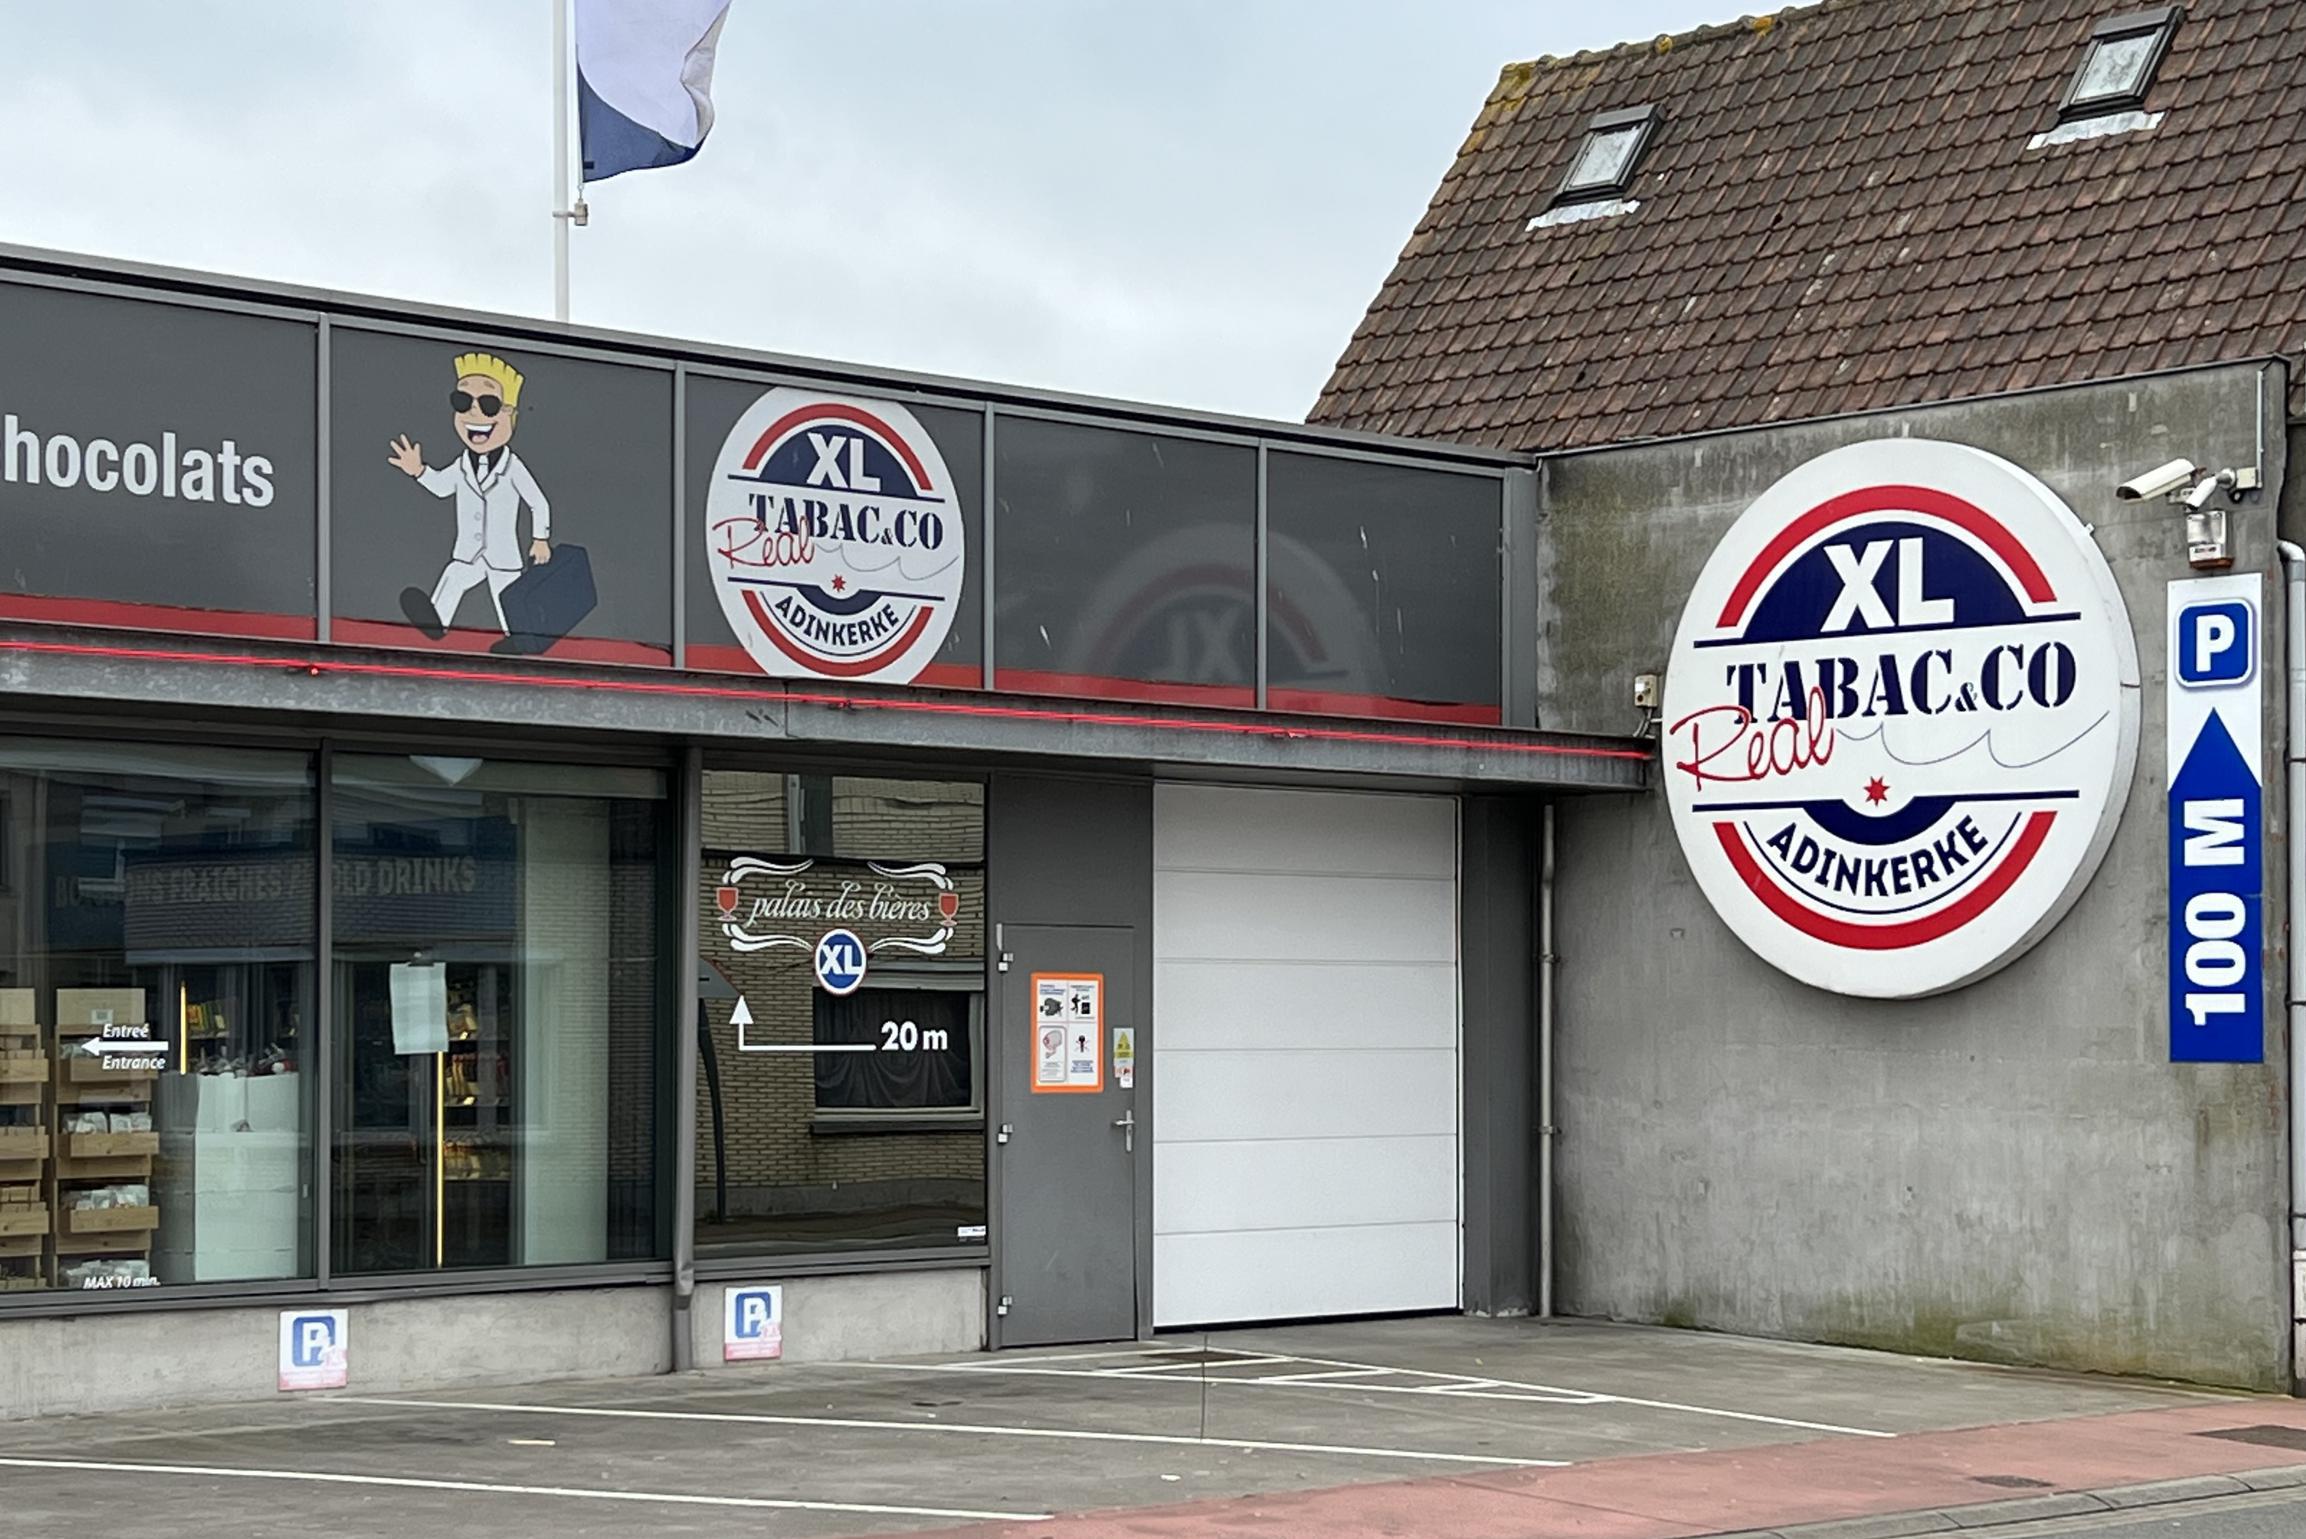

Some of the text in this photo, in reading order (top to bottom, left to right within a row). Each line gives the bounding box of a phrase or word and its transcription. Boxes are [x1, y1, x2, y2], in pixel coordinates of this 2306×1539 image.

[806, 432, 881, 492] XL
[712, 516, 815, 569] Real
[749, 493, 943, 550] TABAC&CO
[1820, 537, 1955, 633] XL
[775, 595, 899, 647] ADINKERKE
[2196, 614, 2235, 672] P
[1726, 641, 2077, 724] TABAC&CO
[1669, 686, 1835, 792] Real
[376, 855, 477, 896] DRINKS
[1766, 815, 1988, 897] ADINKERKE
[742, 880, 822, 929] palais
[825, 880, 866, 919] des
[2183, 799, 2246, 1026] 100 M
[818, 945, 863, 975] XL
[101, 1055, 166, 1070] Entrance
[880, 1020, 948, 1051] 20 m
[83, 1276, 113, 1290] MAX
[115, 1275, 132, 1288] 10
